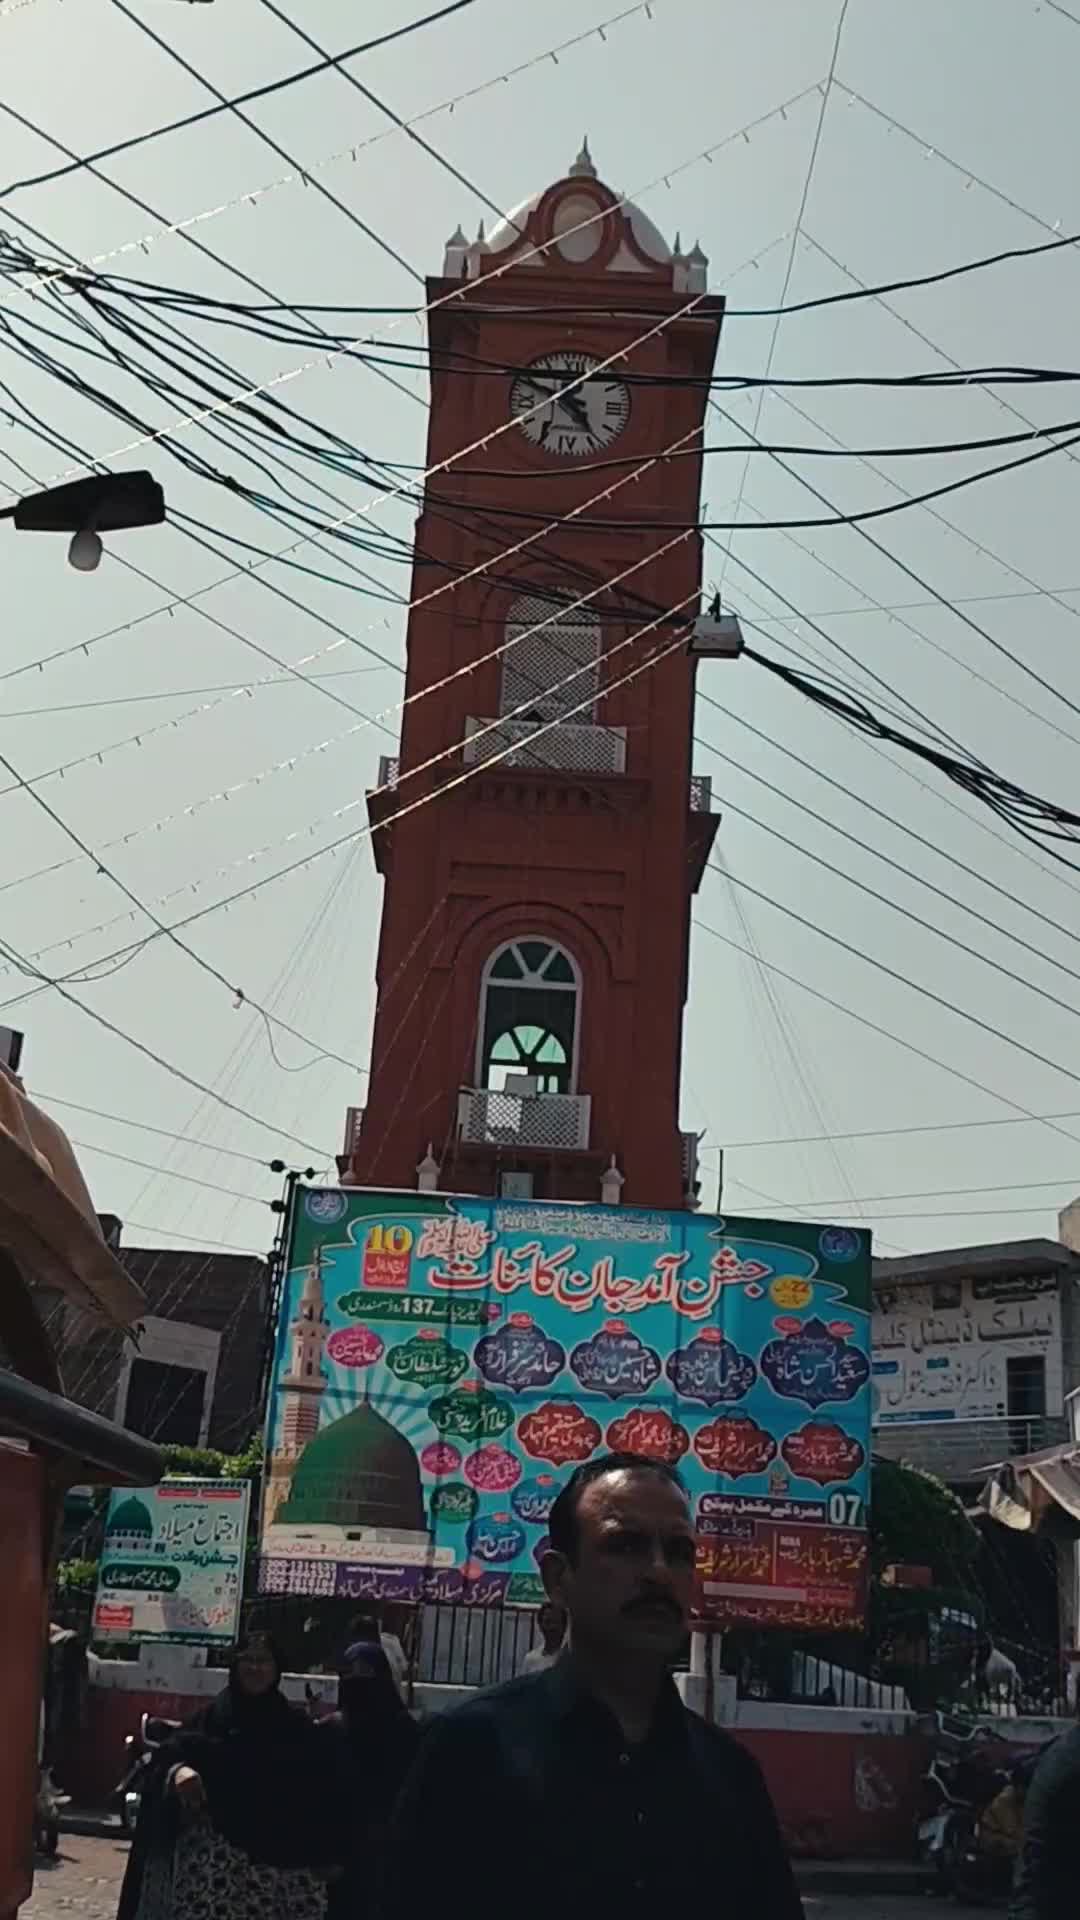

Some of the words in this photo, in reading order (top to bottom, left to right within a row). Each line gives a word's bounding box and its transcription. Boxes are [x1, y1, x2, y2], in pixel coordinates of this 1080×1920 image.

[365, 1224, 413, 1255] 10
[401, 1297, 434, 1315] 137
[829, 1493, 861, 1525] 07
[464, 1578, 503, 1605] مرکزی
